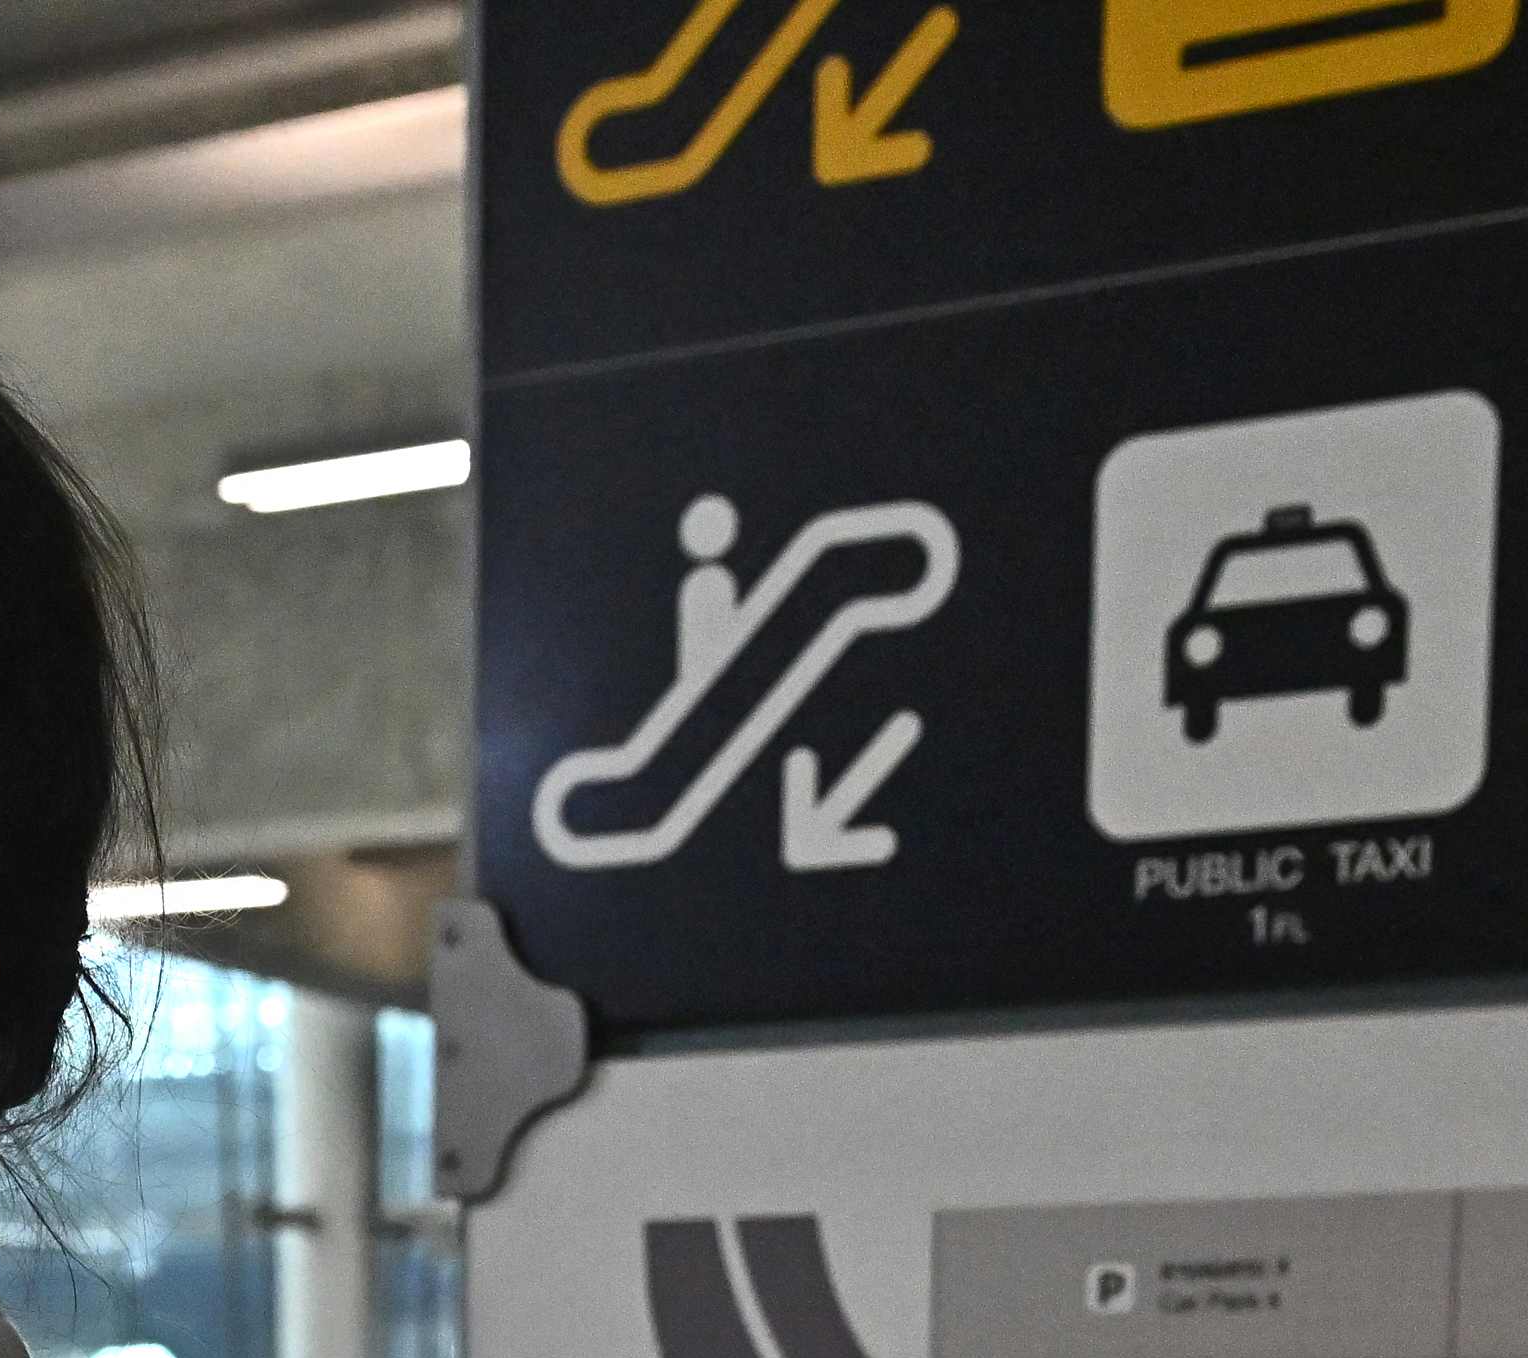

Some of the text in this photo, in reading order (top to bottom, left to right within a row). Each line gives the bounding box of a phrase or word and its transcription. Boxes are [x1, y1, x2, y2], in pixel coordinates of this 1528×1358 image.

[1134, 835, 1434, 902] PUBLIC TAXI
[1099, 1270, 1127, 1304] P
